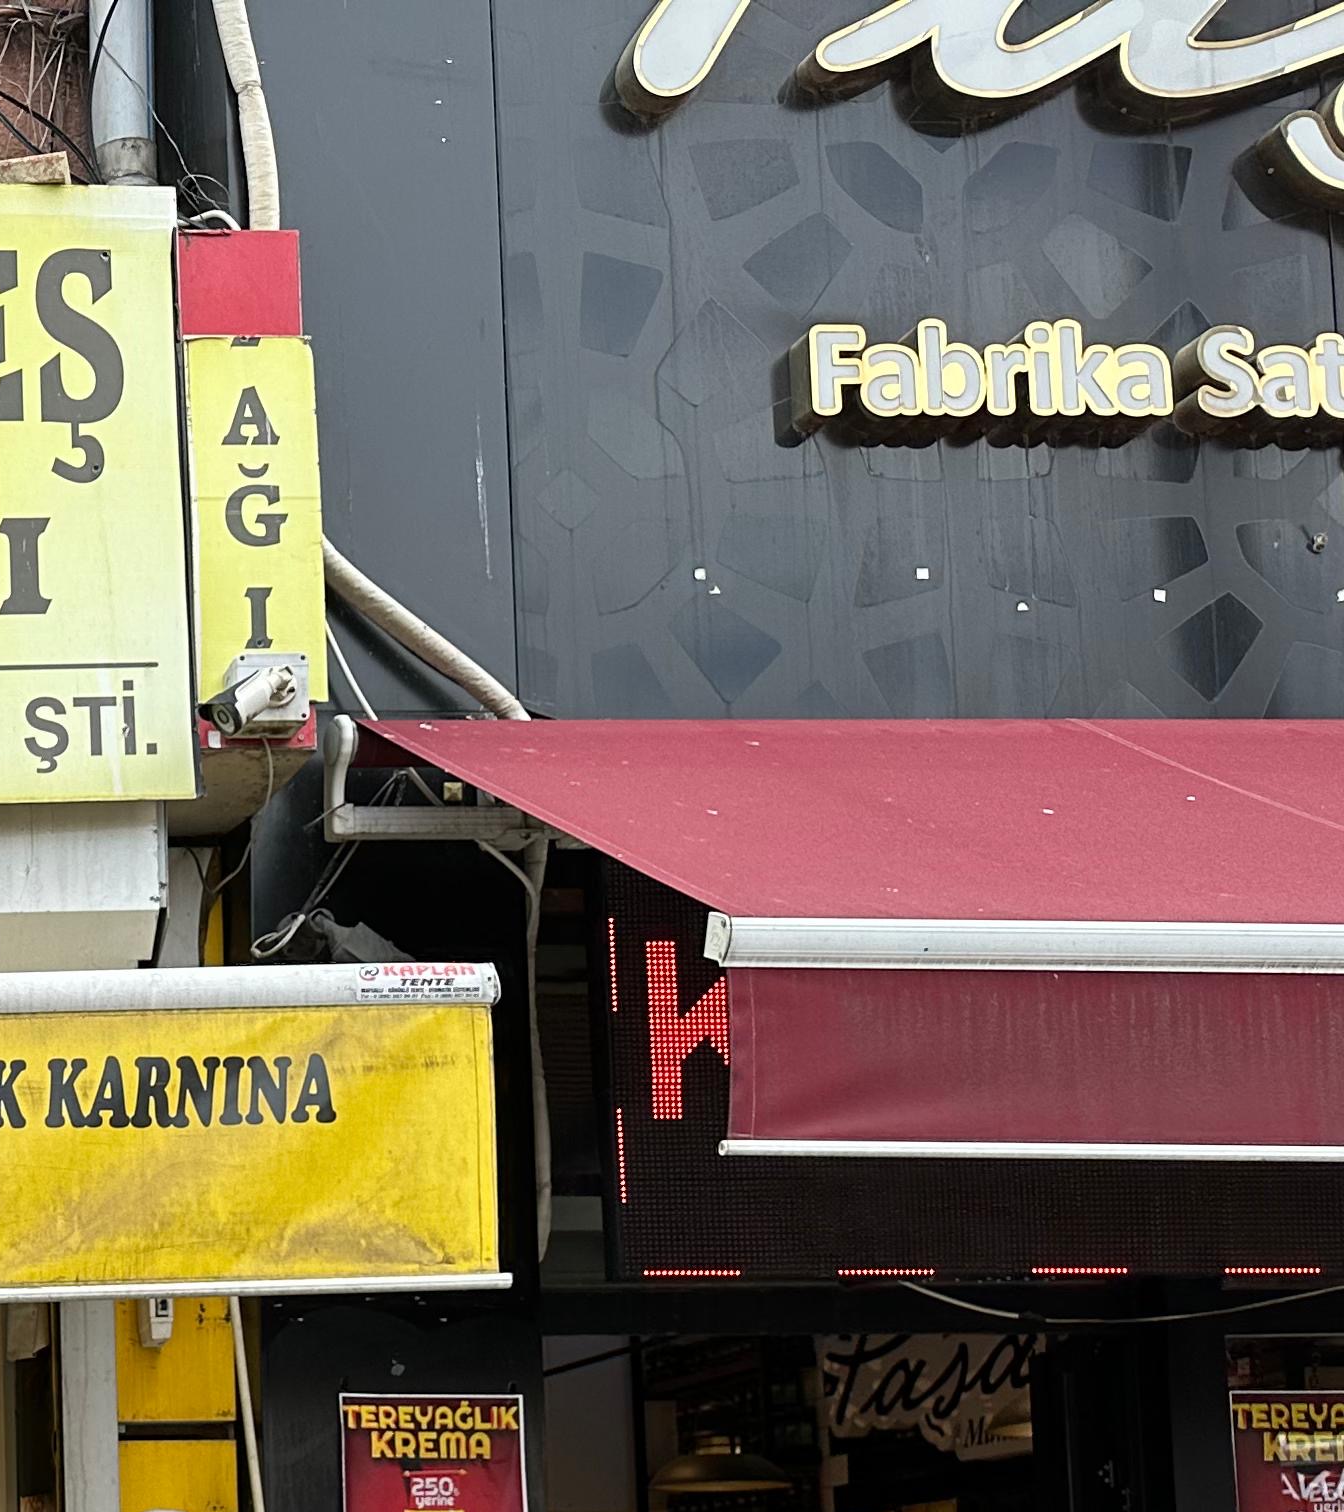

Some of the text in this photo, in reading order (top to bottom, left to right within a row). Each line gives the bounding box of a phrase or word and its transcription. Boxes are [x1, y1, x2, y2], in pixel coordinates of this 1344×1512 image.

[808, 318, 1174, 420] Fabrika
[222, 337, 288, 648] AĞI
[24, 679, 158, 774] ŞTİ.
[383, 965, 476, 977] KAPLAN
[400, 978, 456, 987] TENTE
[44, 1053, 337, 1129] KARNINA
[343, 1401, 520, 1430] TEREYAĞLIK
[371, 1430, 492, 1459] KREMA
